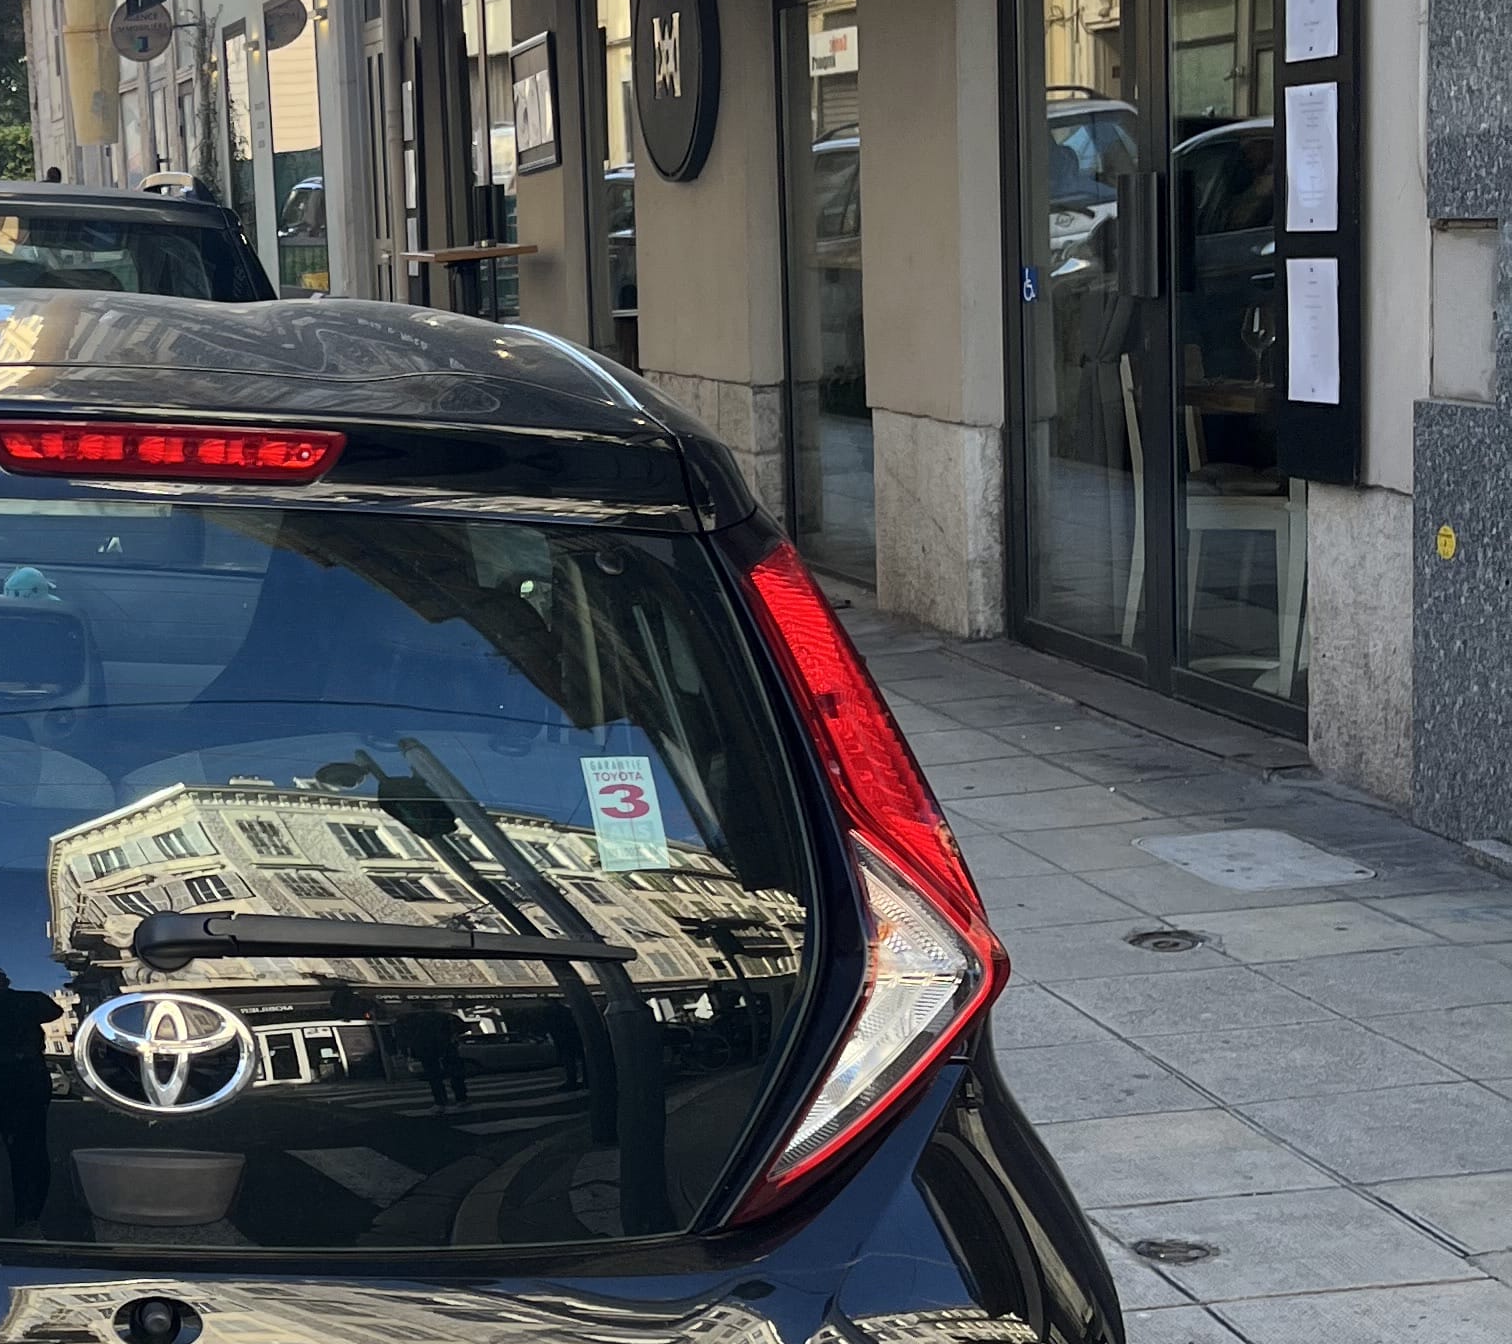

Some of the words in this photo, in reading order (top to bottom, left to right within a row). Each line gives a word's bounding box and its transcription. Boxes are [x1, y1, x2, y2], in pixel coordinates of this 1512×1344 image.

[589, 759, 642, 772] GARANTIE
[592, 771, 644, 782] TOYOTA
[598, 783, 651, 819] 3
